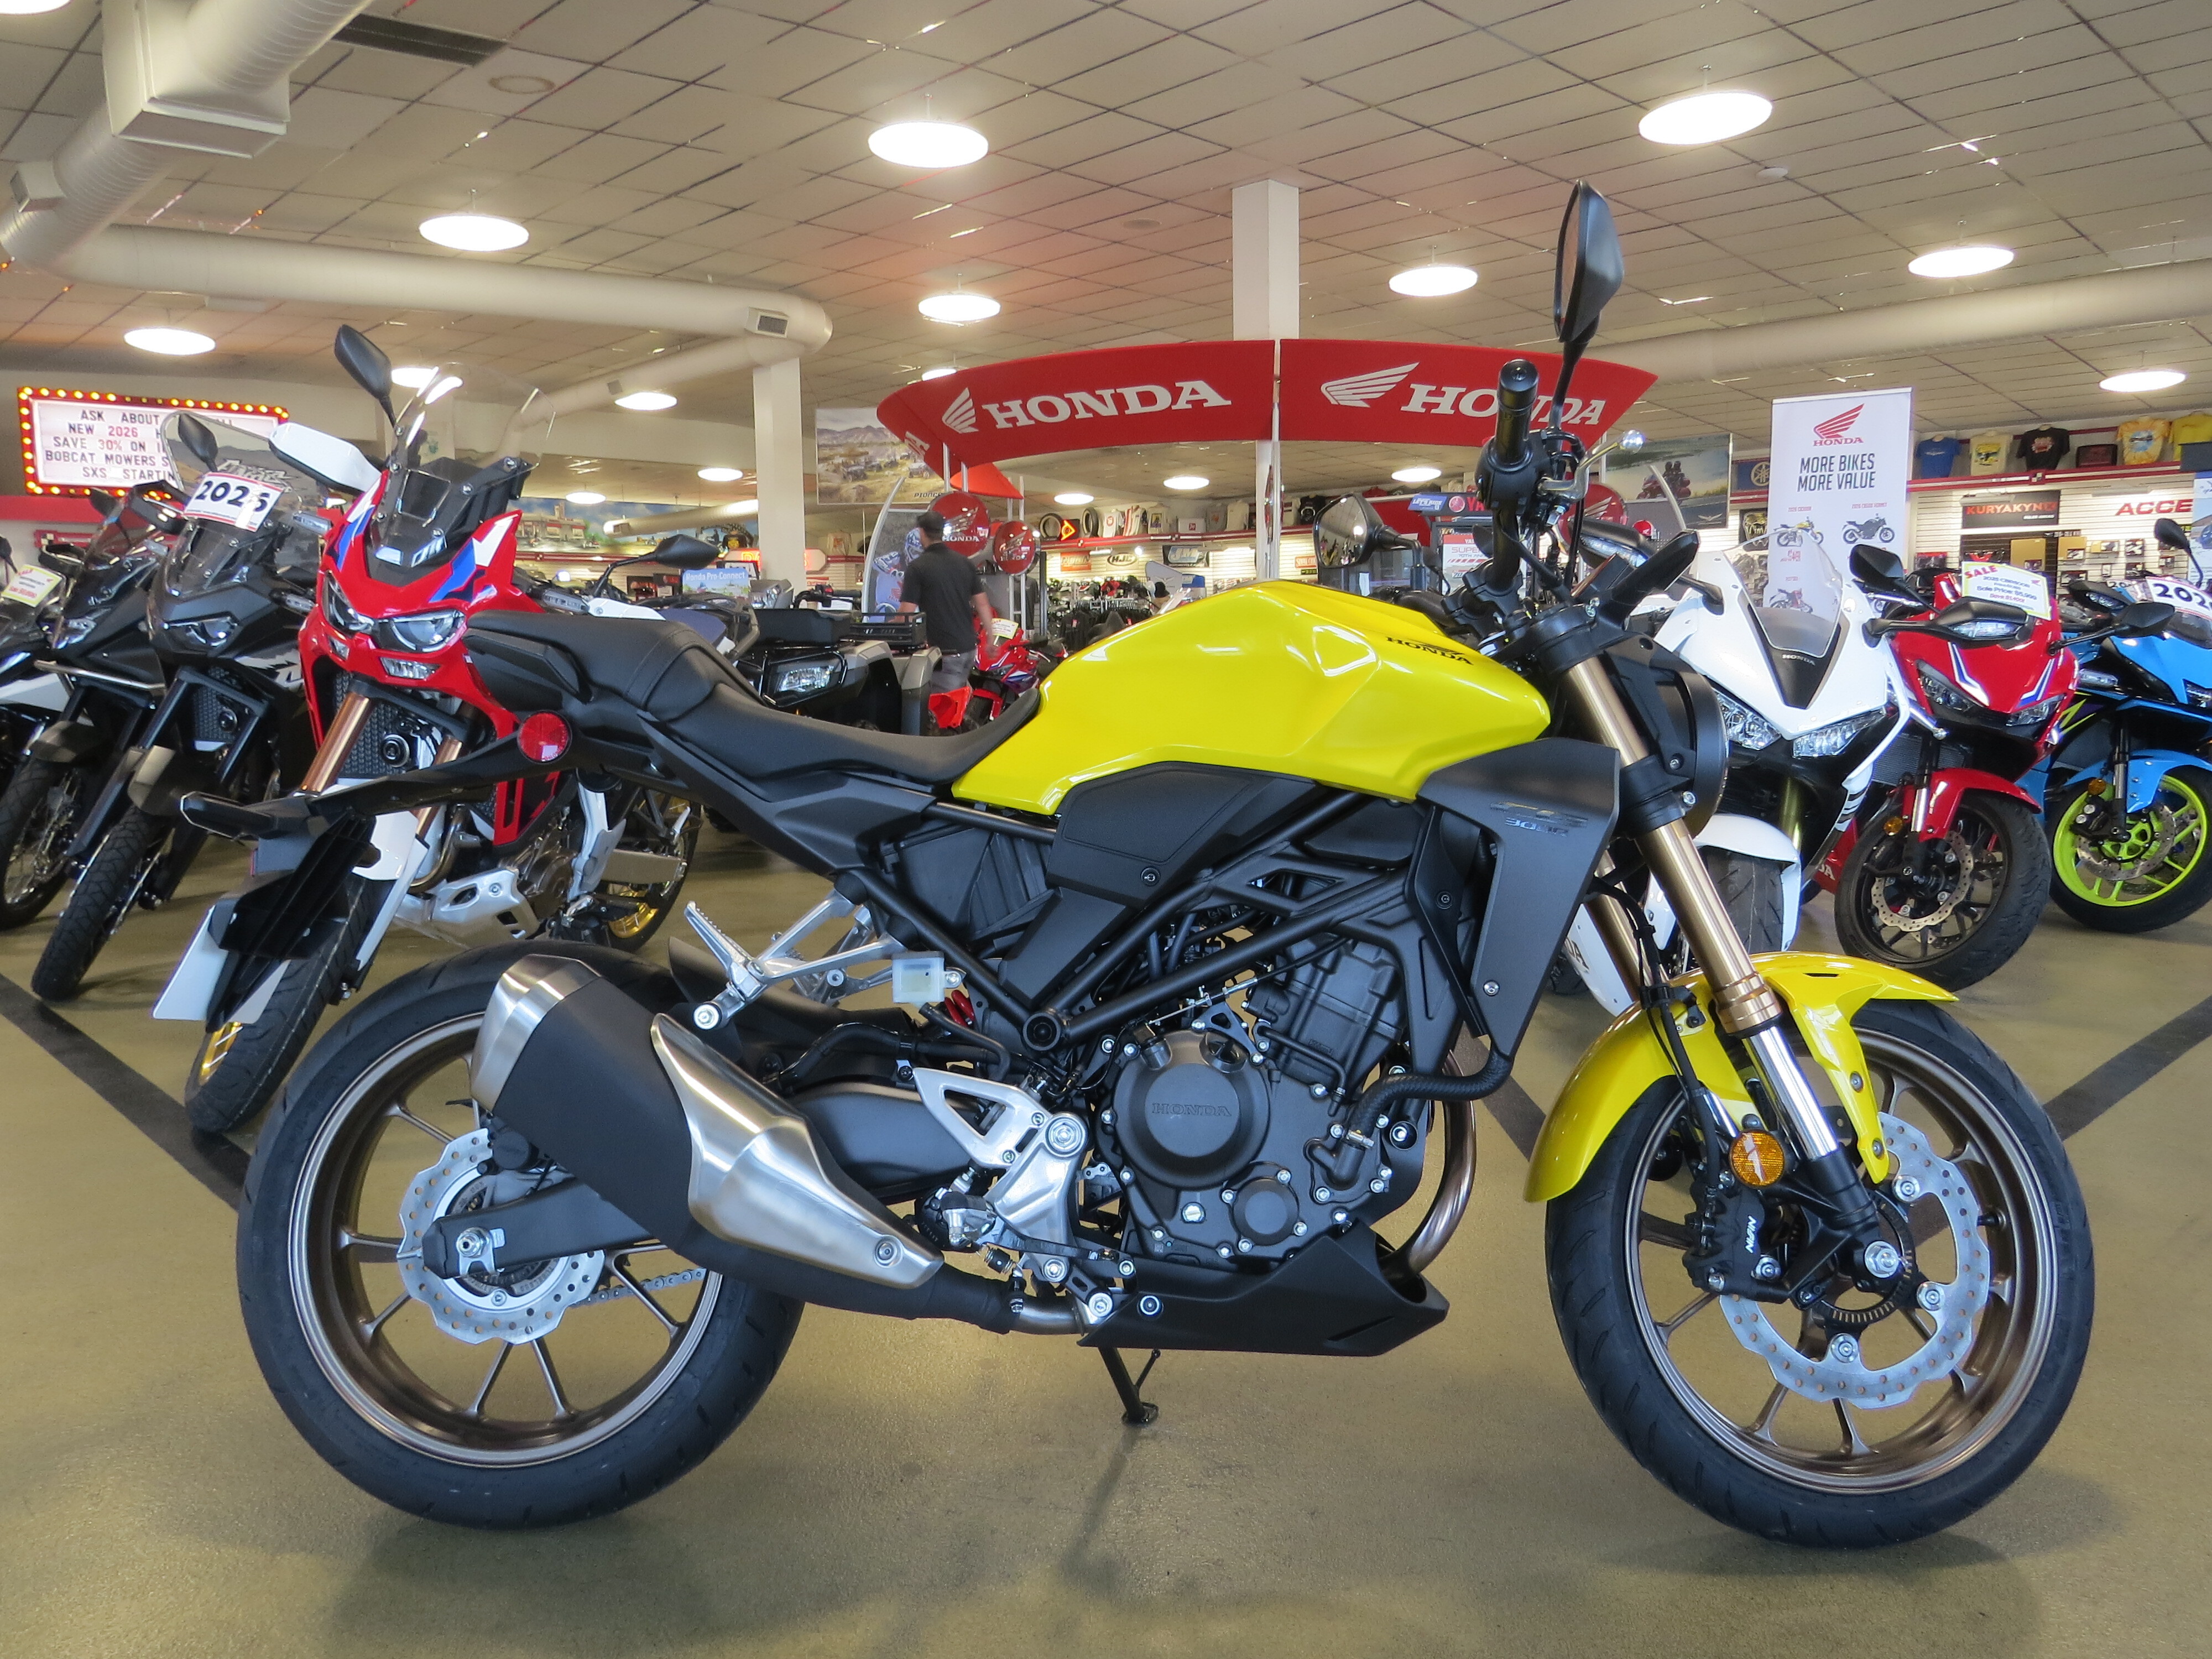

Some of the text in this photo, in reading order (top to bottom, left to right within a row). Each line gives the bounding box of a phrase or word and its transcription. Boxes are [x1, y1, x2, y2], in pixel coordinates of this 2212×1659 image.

[982, 380, 1232, 430] HONDA
[1401, 383, 1606, 426] HODA
[81, 410, 160, 425] ASK ABOUT
[68, 422, 138, 437] NEW 2026
[53, 436, 87, 449] SAVE
[98, 439, 123, 451] 30%
[131, 441, 146, 452] ON
[1813, 437, 1864, 446] HONDA
[45, 450, 96, 463] BOBCAT
[105, 454, 155, 466] MOWERS
[1799, 453, 1875, 474] MORE BIKES
[82, 467, 107, 478] SXS
[1797, 471, 1876, 492] MORE VALUE
[1966, 503, 2042, 515] KURYAKYN
[686, 572, 706, 581] Honda
[707, 571, 745, 580] Pro-Connect
[1964, 565, 1998, 579] SALE
[2153, 583, 2212, 611] 202
[1386, 637, 1474, 666] HONDA
[1782, 654, 1816, 666] HONDA
[1152, 1103, 1232, 1117] HONDA
